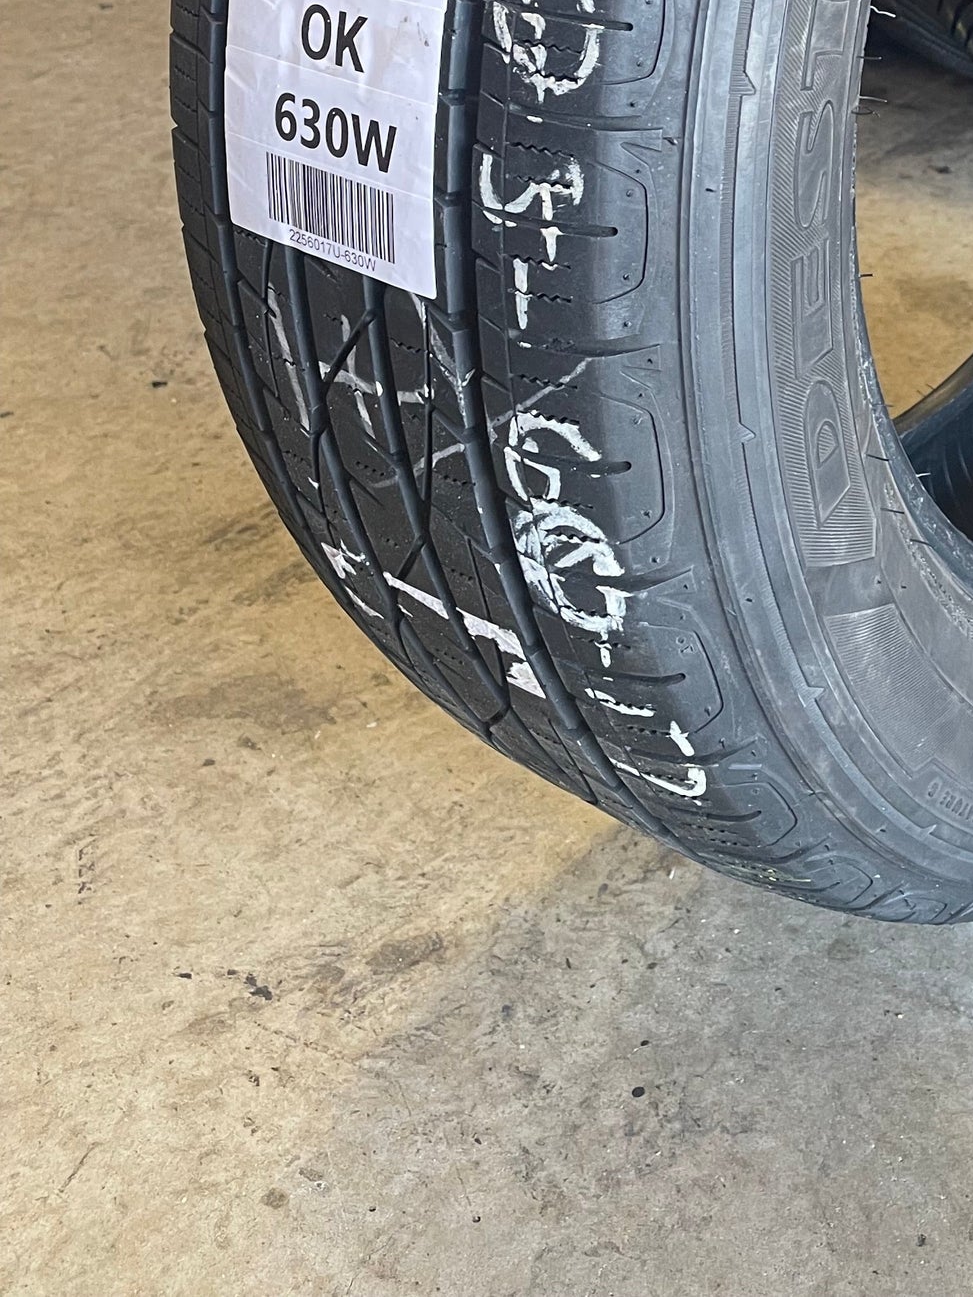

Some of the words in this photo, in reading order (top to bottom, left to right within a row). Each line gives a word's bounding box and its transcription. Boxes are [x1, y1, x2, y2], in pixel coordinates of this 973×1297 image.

[301, 4, 368, 73] OK
[274, 93, 397, 174] 630W
[288, 228, 377, 273] 2256017U-630W
